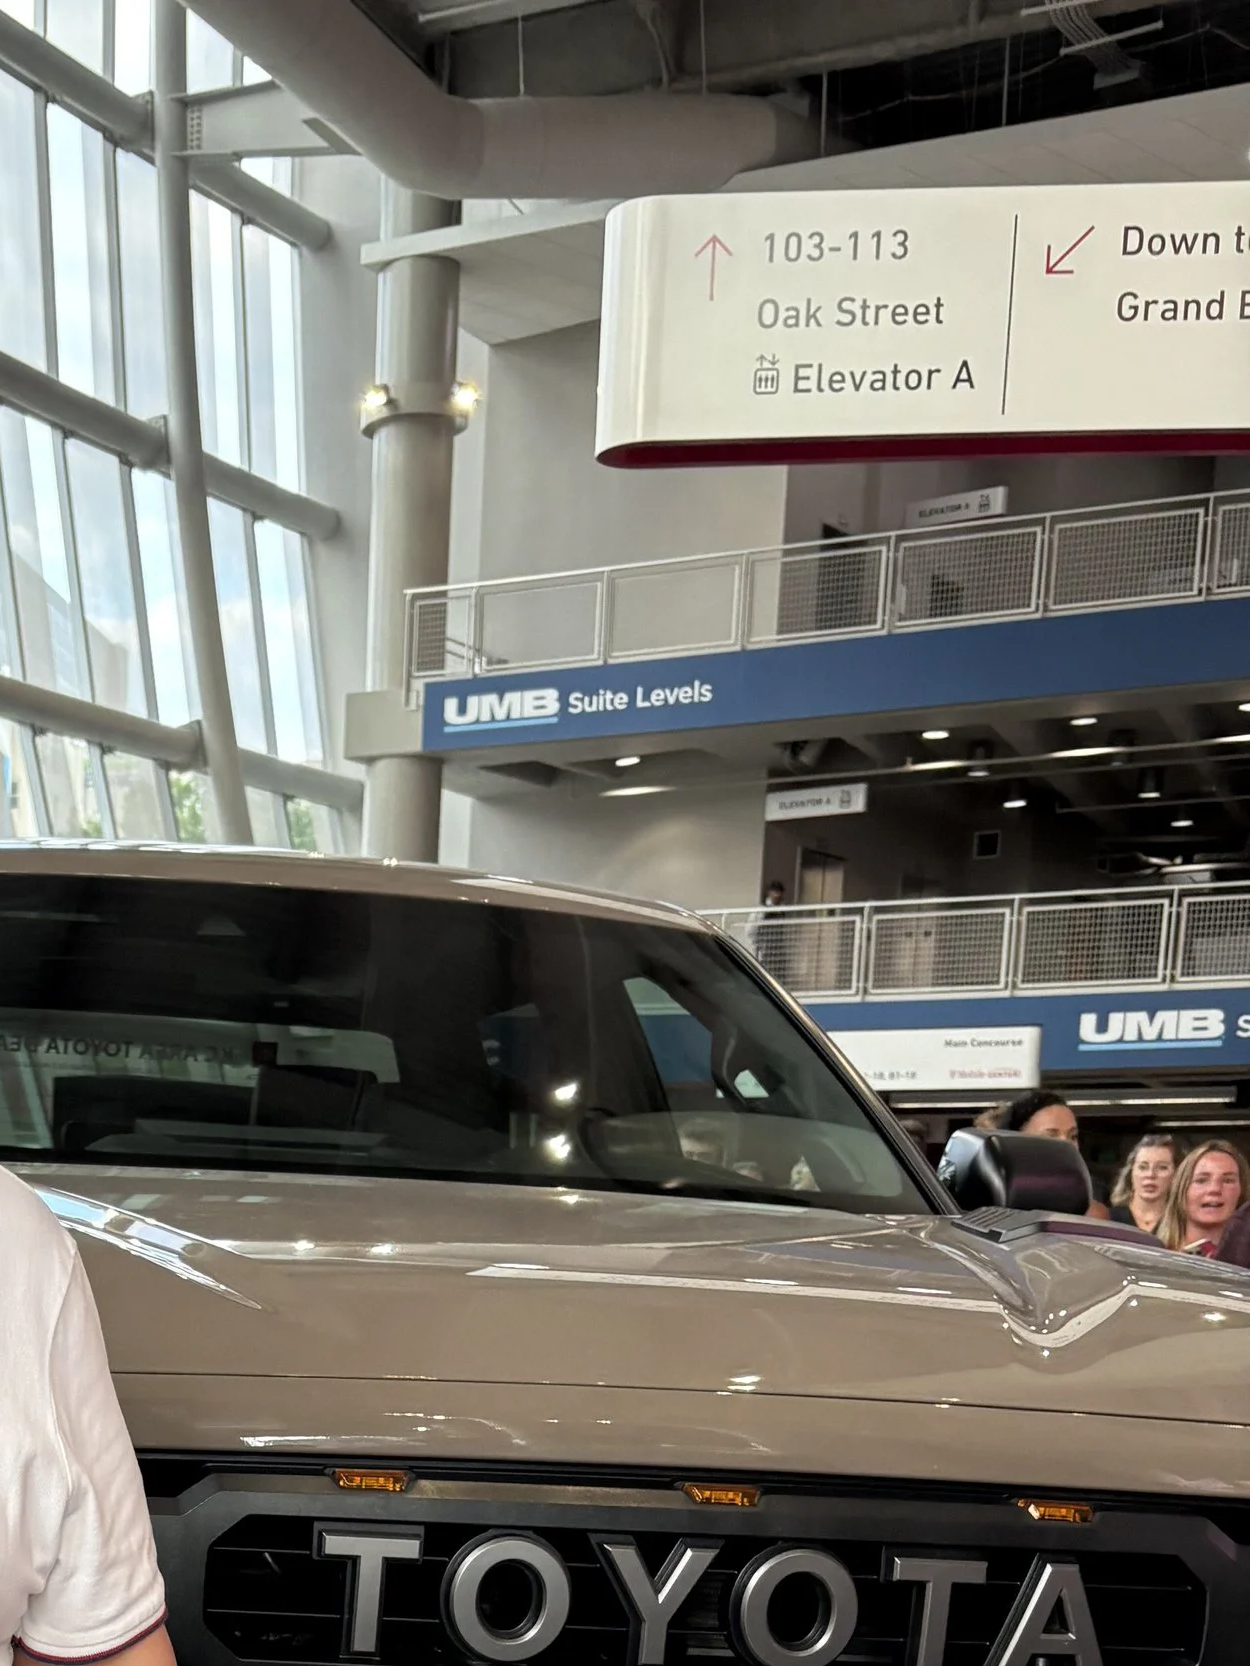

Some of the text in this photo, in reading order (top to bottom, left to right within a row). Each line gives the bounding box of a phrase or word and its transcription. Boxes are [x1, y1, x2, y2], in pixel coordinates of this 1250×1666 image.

[762, 230, 910, 264] 103-113
[1121, 225, 1221, 256] Down
[757, 295, 945, 328] Oak Street
[1116, 289, 1226, 322] Grand
[791, 359, 976, 395] Elevator A
[443, 679, 714, 725] UMB Suite Levels
[1078, 1008, 1226, 1044] UMB
